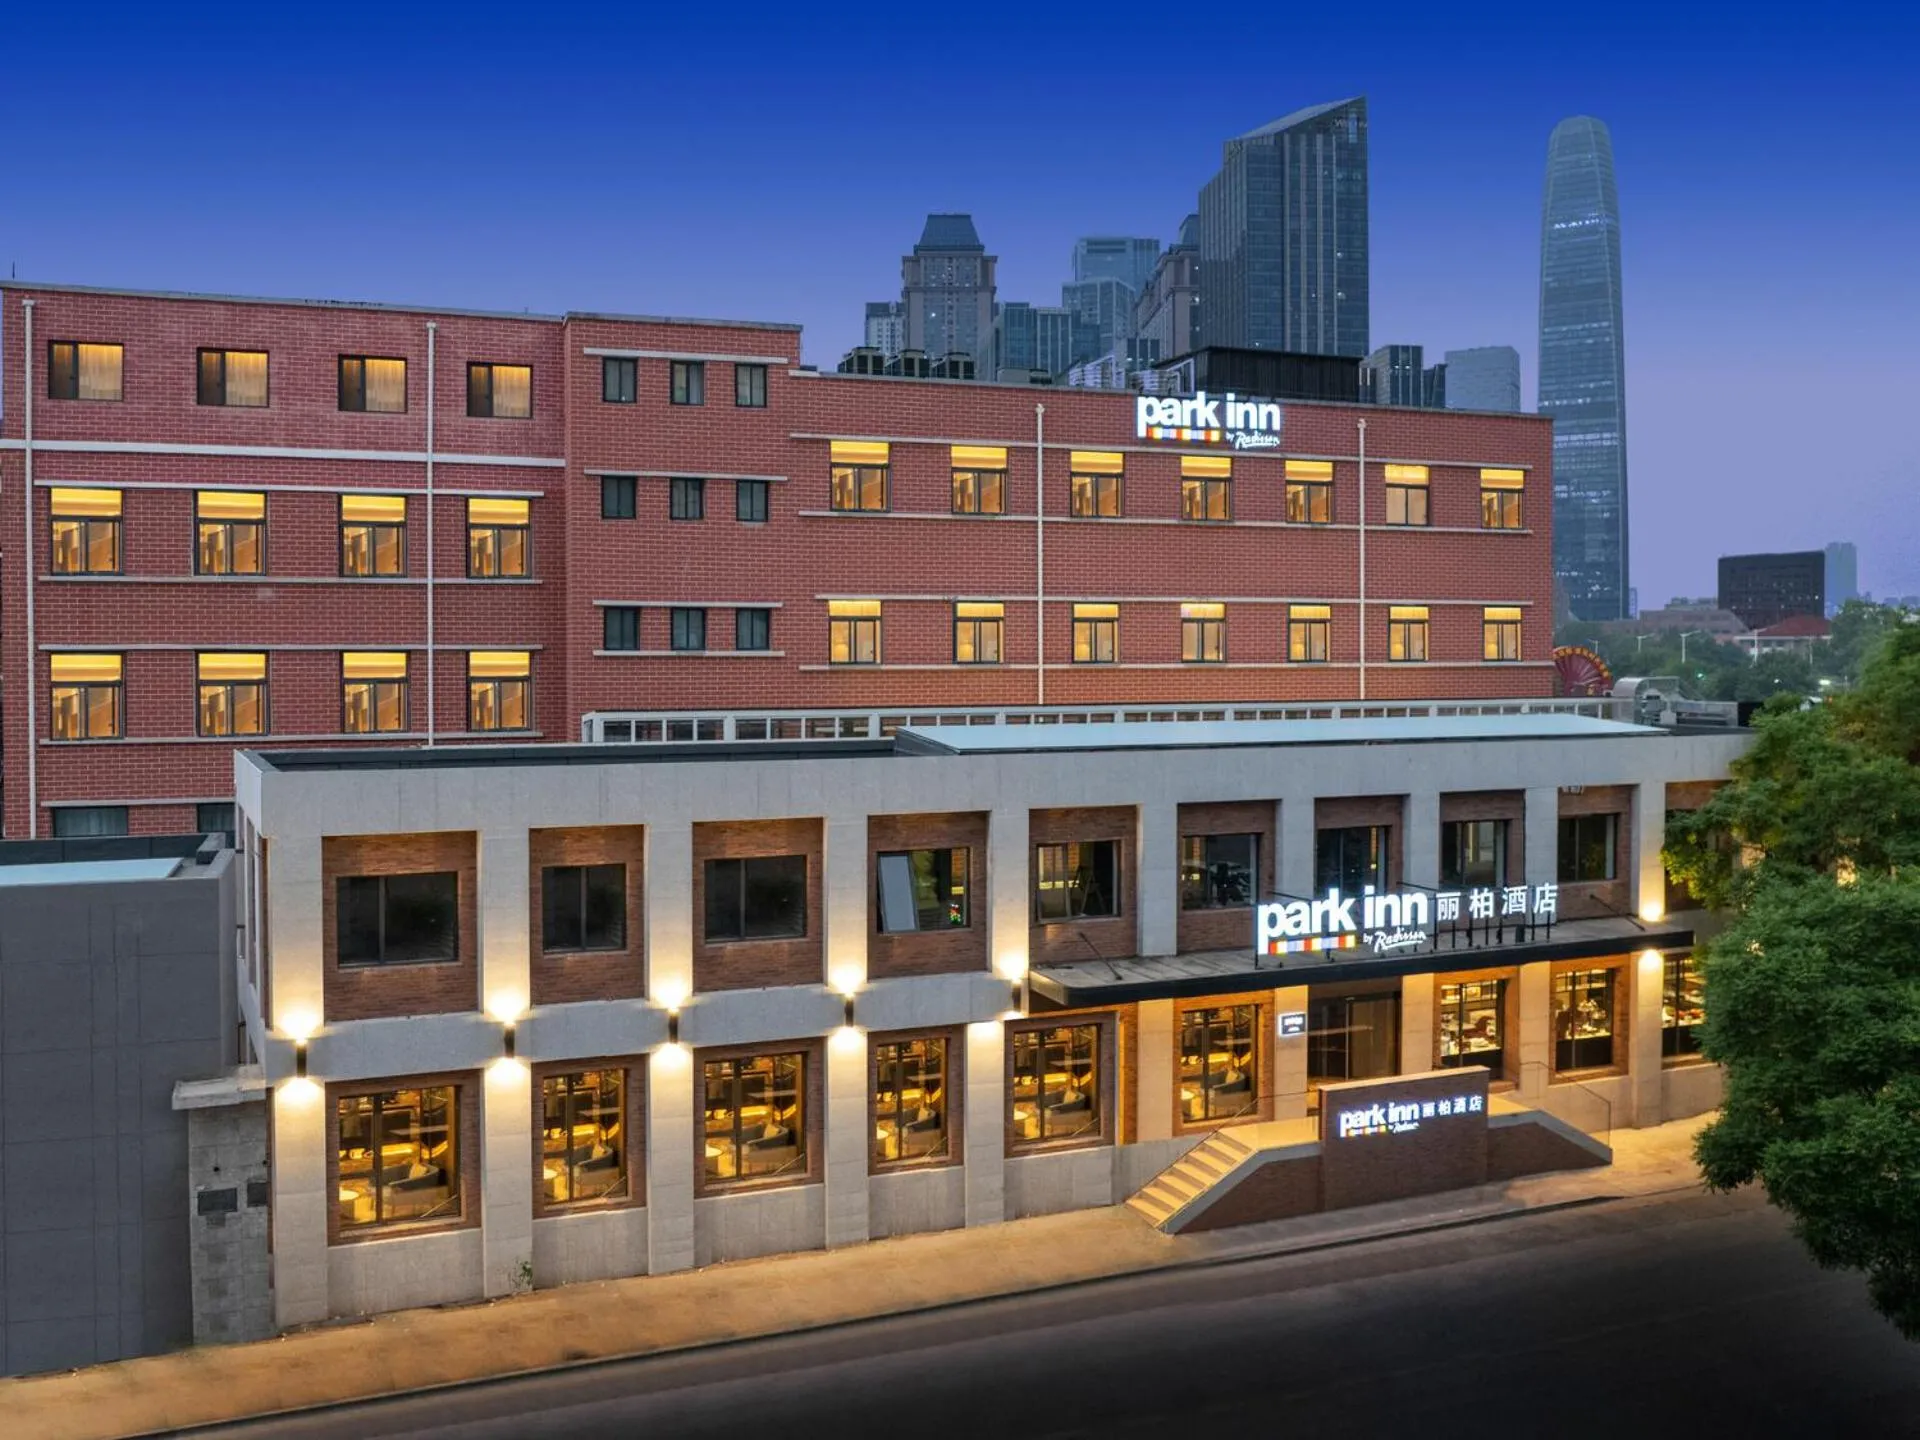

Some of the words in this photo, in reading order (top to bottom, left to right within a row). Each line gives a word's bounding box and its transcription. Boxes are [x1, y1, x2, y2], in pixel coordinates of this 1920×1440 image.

[1137, 391, 1220, 438] park
[1226, 393, 1281, 430] inn
[1258, 887, 1357, 955] park
[1364, 885, 1428, 929] inn
[1435, 882, 1558, 921] 丽柏酒店
[1374, 926, 1427, 953] Radisson
[1340, 1103, 1387, 1138] park
[1388, 1102, 1420, 1123] inn
